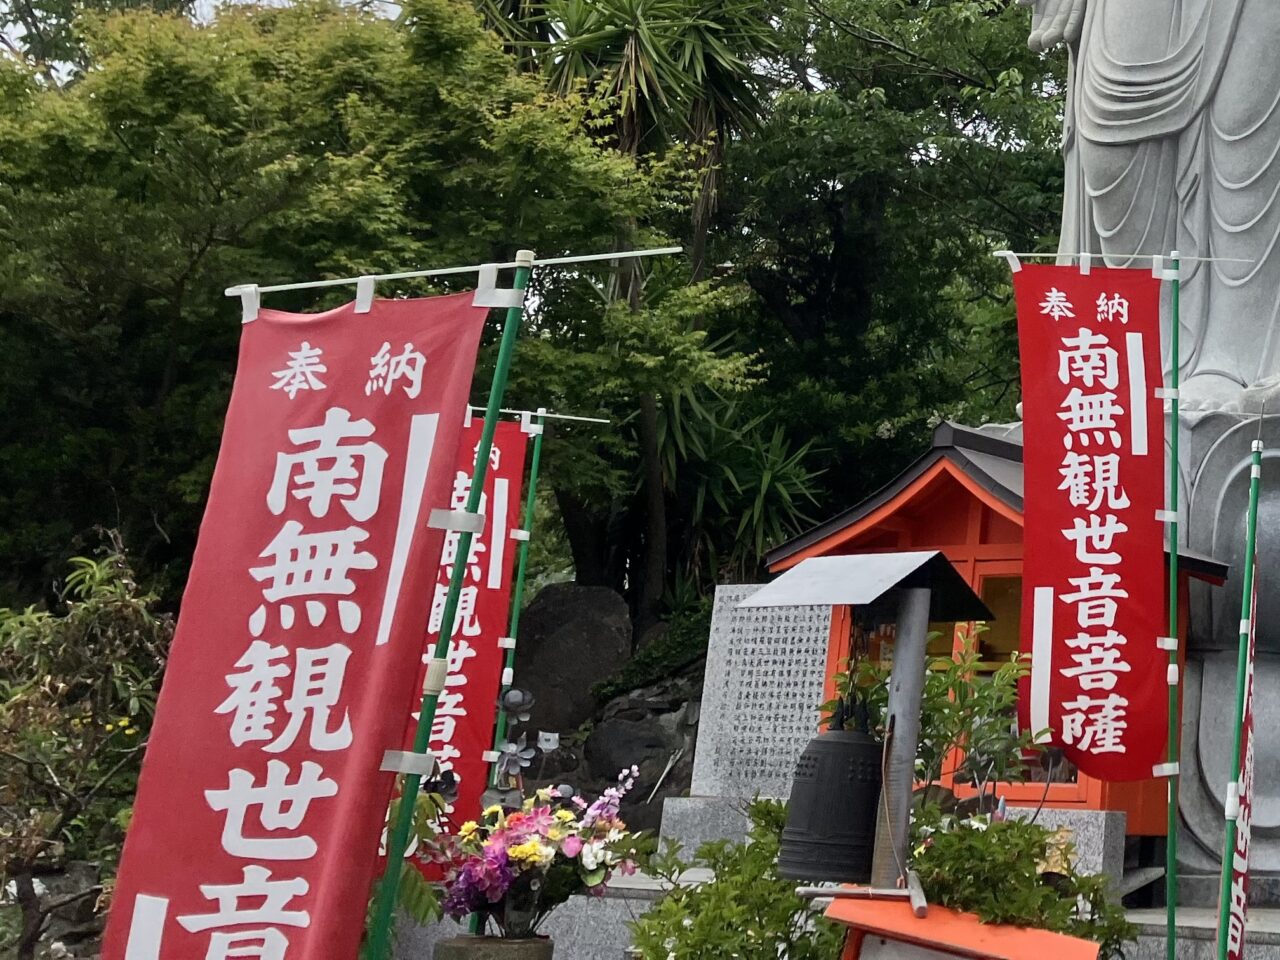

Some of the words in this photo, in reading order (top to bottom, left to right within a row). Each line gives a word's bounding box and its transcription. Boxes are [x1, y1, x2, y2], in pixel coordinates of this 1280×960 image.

[271, 341, 427, 401] 奉納
[1039, 286, 1130, 325] 奉納
[1057, 327, 1132, 755] 南無観世音菩薩
[175, 407, 389, 960] 南無観世音
